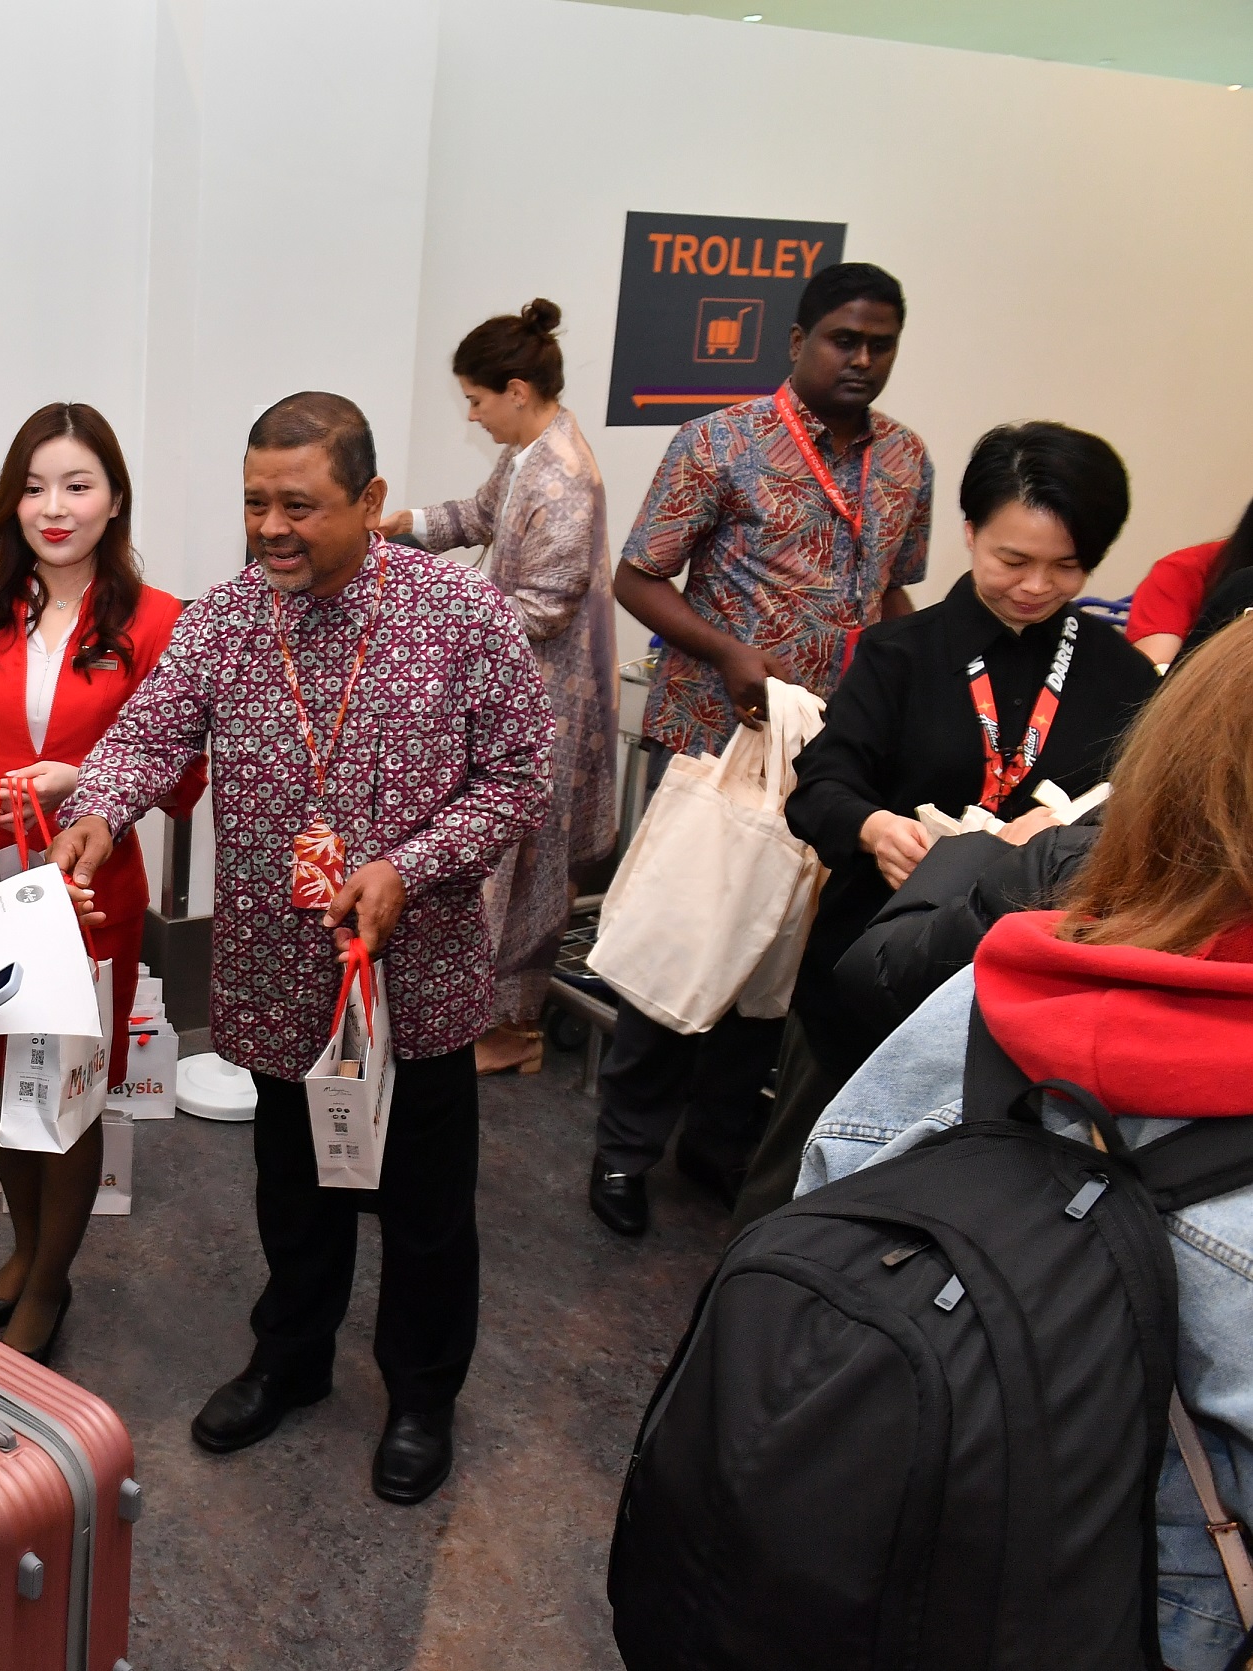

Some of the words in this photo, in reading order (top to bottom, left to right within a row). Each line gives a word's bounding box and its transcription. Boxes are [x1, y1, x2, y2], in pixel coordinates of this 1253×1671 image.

[648, 232, 825, 279] TROLLEY
[1046, 638, 1075, 692] DARE
[1062, 615, 1080, 640] TO
